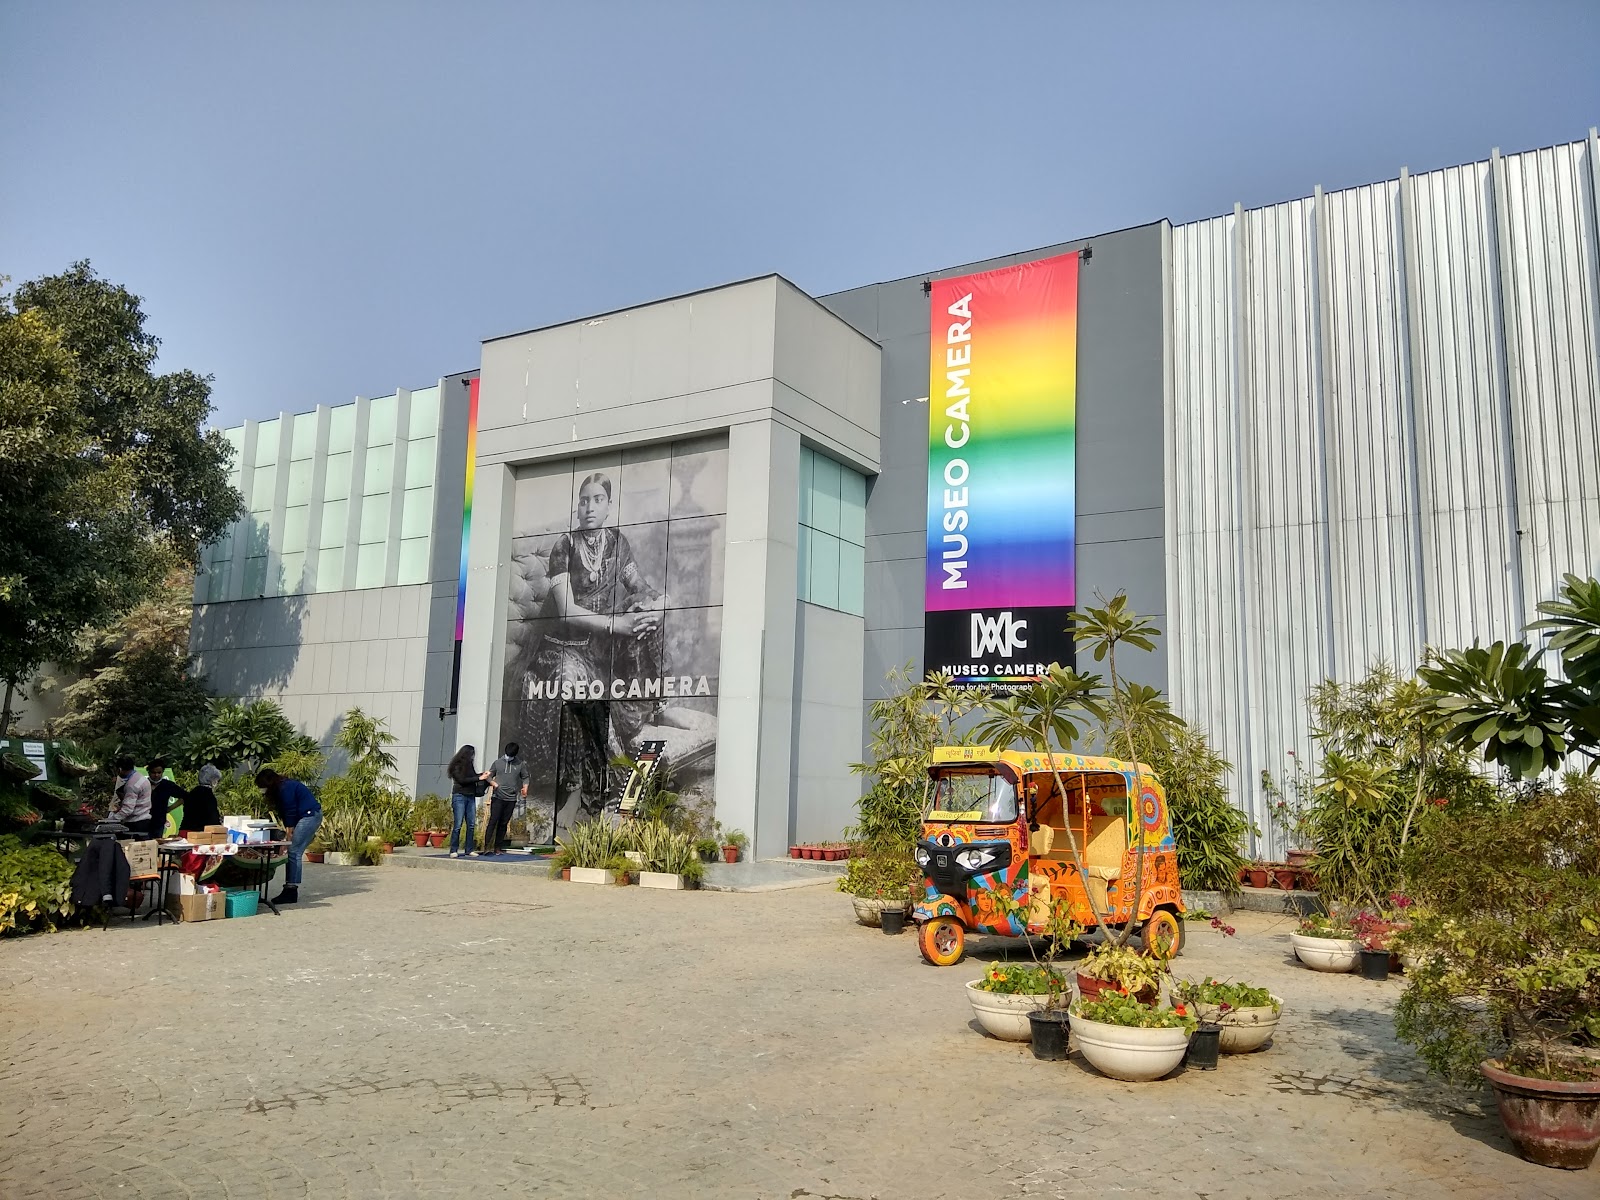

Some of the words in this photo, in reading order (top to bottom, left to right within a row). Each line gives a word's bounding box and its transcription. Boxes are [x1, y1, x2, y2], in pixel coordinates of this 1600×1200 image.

[944, 292, 973, 449] CAMERA
[943, 458, 970, 590] MUSEO
[942, 664, 989, 675] MUSEO
[528, 679, 605, 700] MUSEO
[610, 675, 711, 698] CAMERA
[966, 683, 977, 691] for
